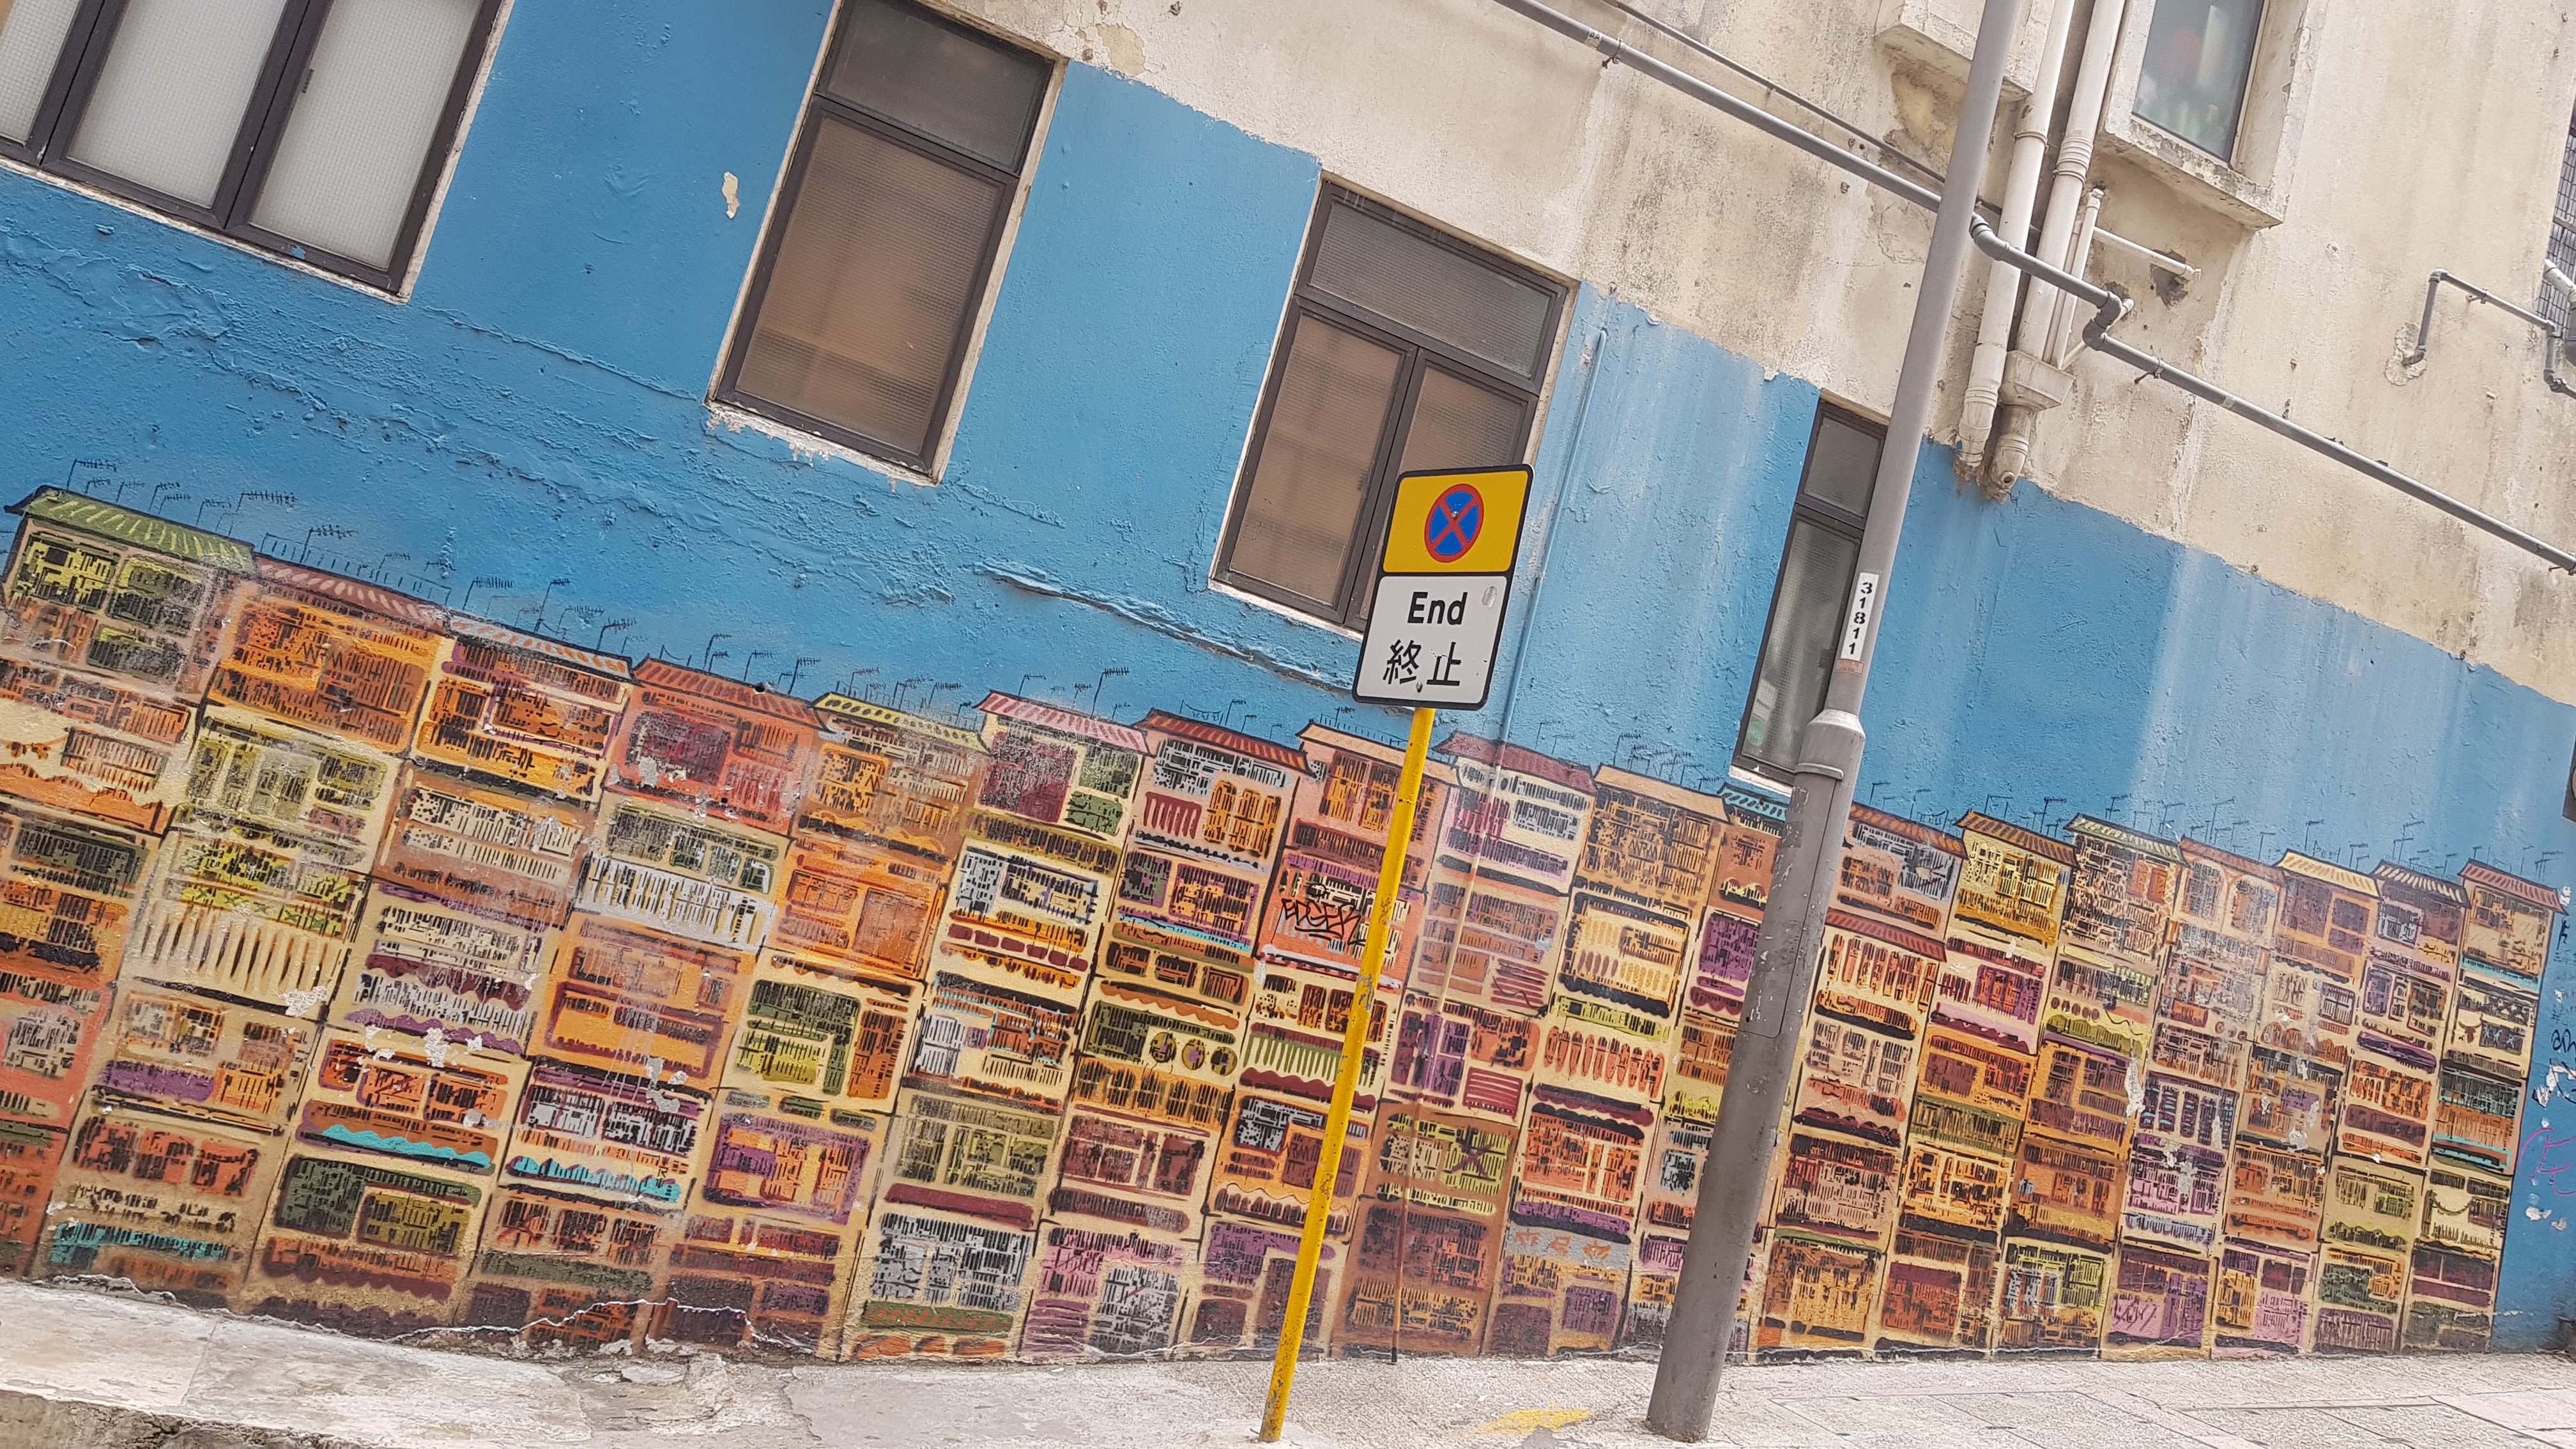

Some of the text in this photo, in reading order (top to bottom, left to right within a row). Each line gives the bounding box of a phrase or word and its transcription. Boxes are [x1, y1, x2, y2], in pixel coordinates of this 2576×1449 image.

[1407, 592, 1468, 625] End
[1849, 582, 1873, 654] 31811
[1383, 640, 1462, 686] 終止
